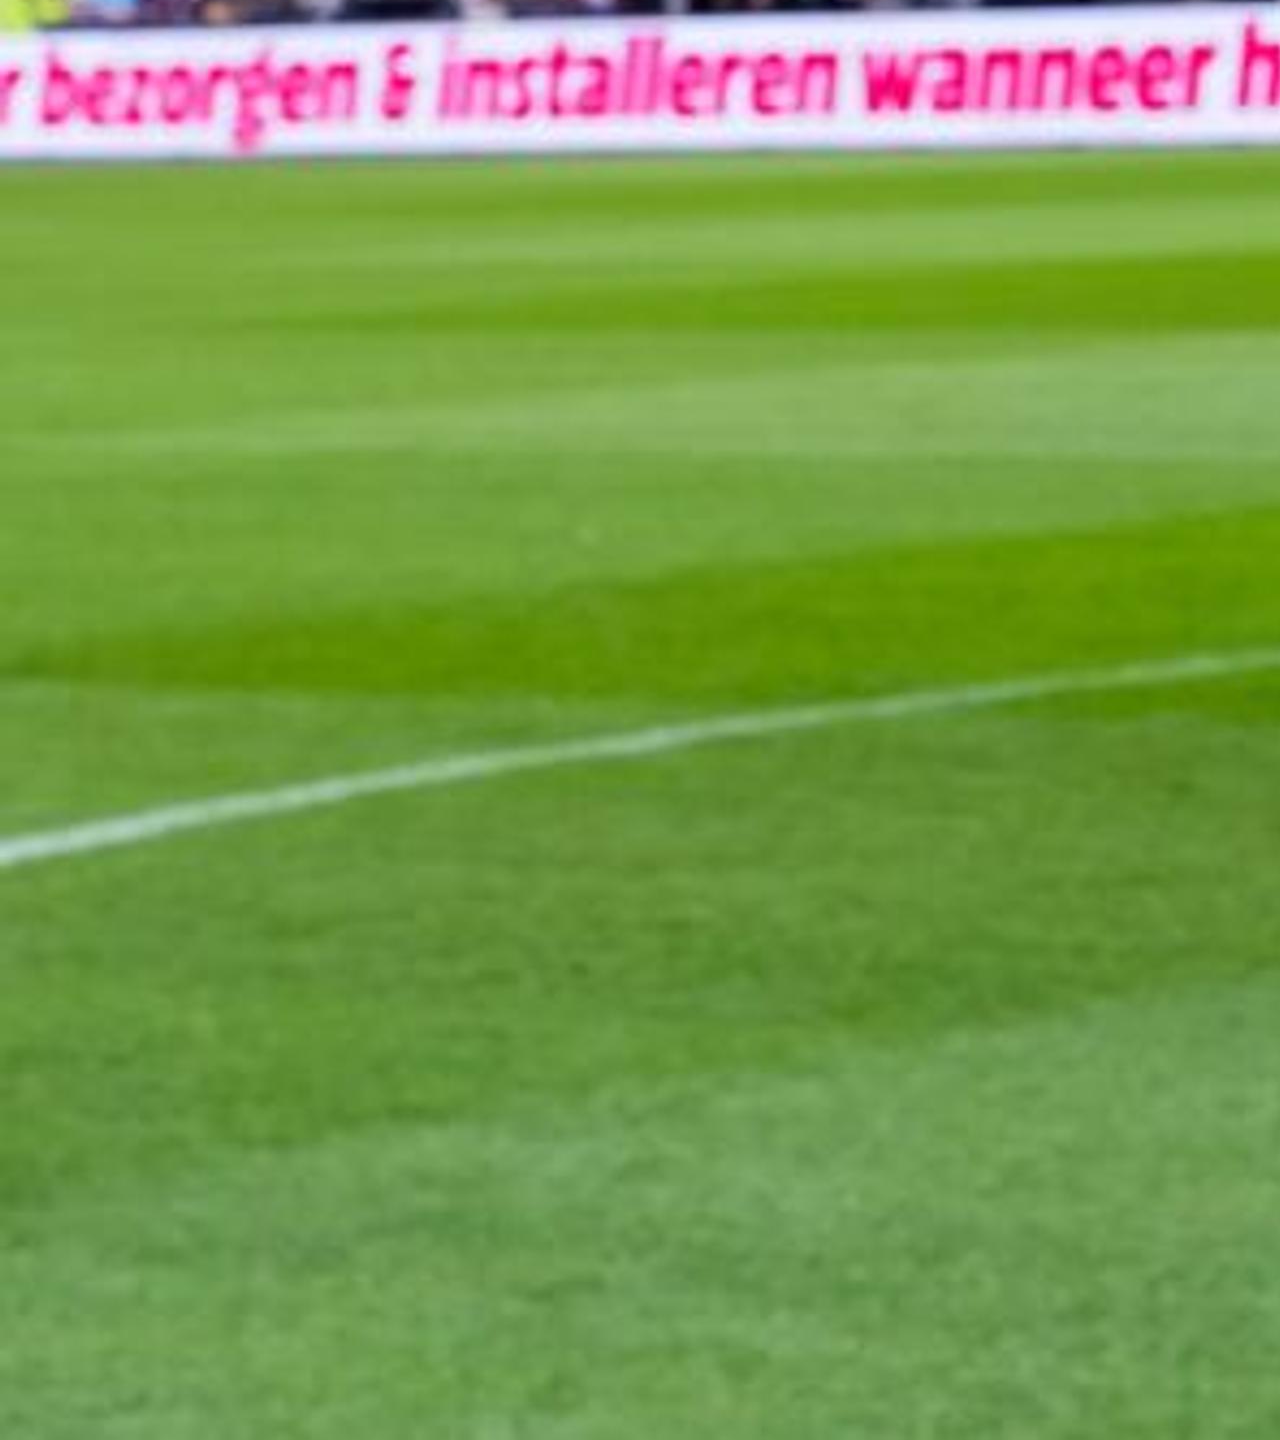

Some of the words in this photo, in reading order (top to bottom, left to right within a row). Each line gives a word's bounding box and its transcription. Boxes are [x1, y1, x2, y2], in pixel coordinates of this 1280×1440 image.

[43, 42, 357, 155] bezorgen
[438, 34, 839, 118] installeren
[861, 43, 1218, 113] wanneer
